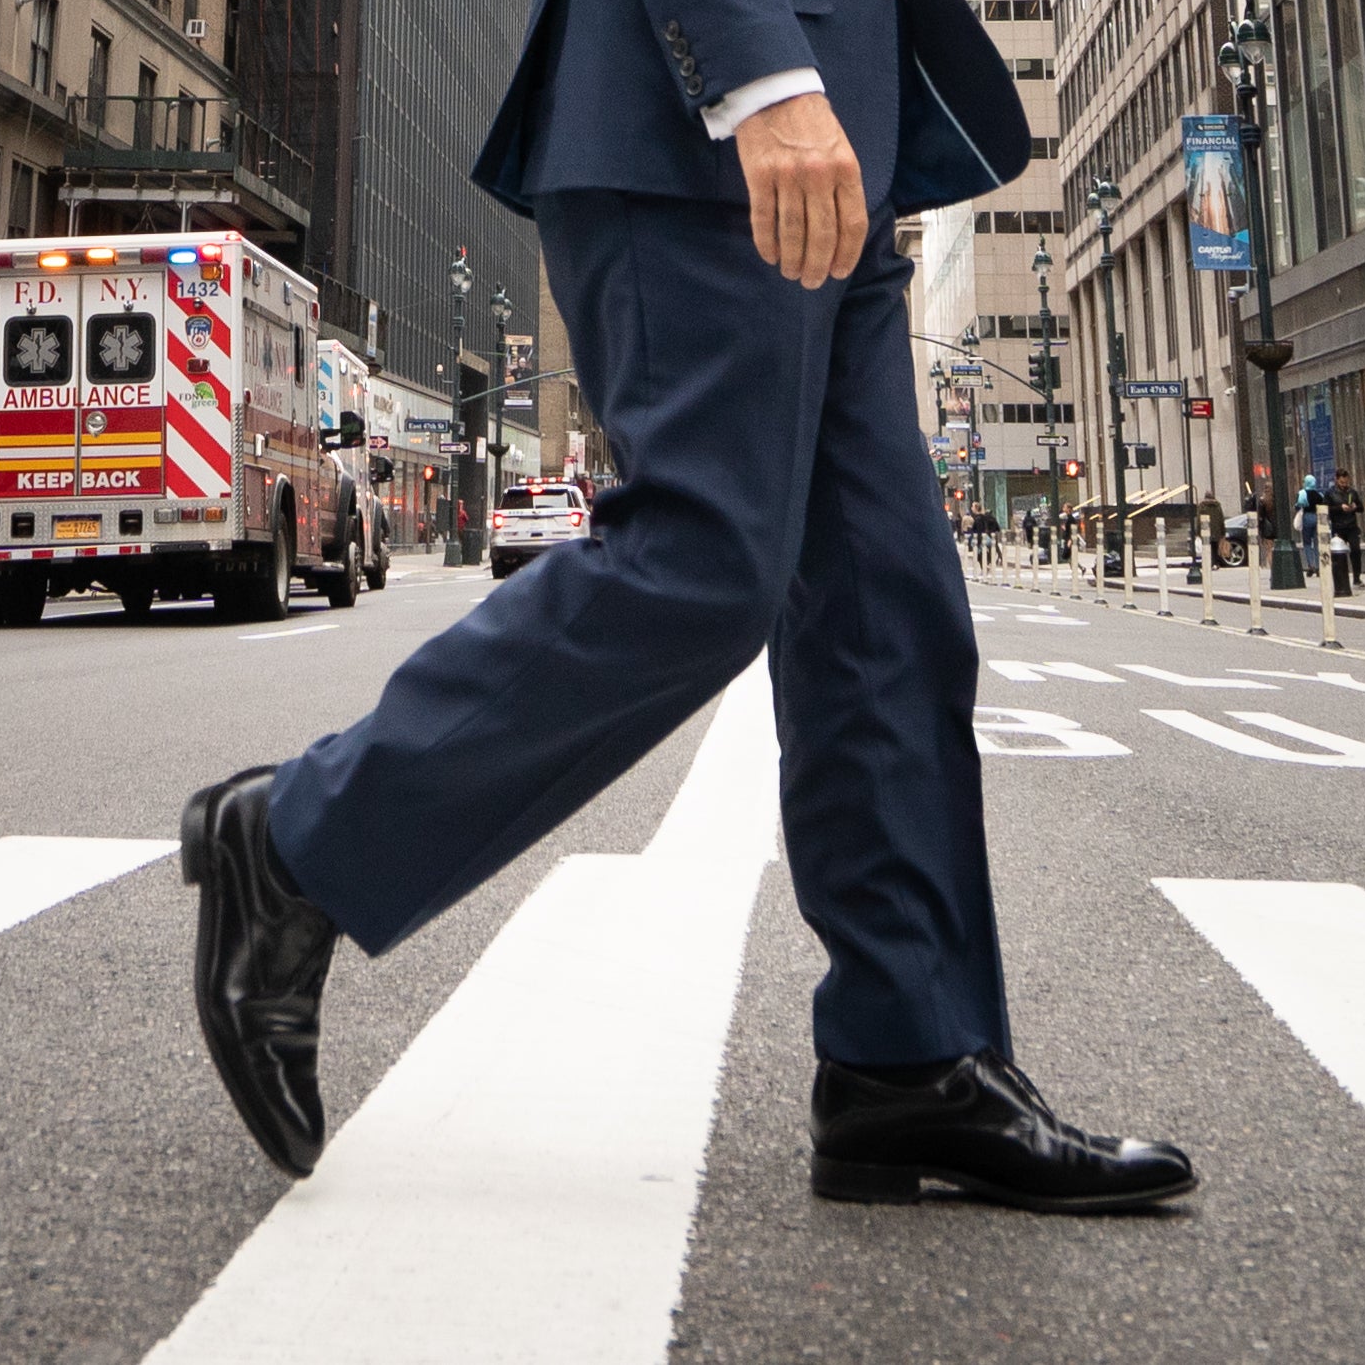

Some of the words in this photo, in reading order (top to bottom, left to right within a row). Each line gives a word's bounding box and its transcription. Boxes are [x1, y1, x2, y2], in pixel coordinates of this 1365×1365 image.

[1186, 136, 1237, 145] FINANCIAL
[14, 280, 63, 304] F.D.
[101, 277, 147, 301] N.Y.
[178, 281, 219, 298] 1432
[3, 385, 151, 410] AMBULANCE
[1130, 385, 1149, 394] East
[1149, 385, 1168, 395] 47th
[1169, 385, 1178, 394] St
[191, 399, 217, 409] green
[17, 472, 74, 490] KEEP
[81, 470, 141, 489] BACK
